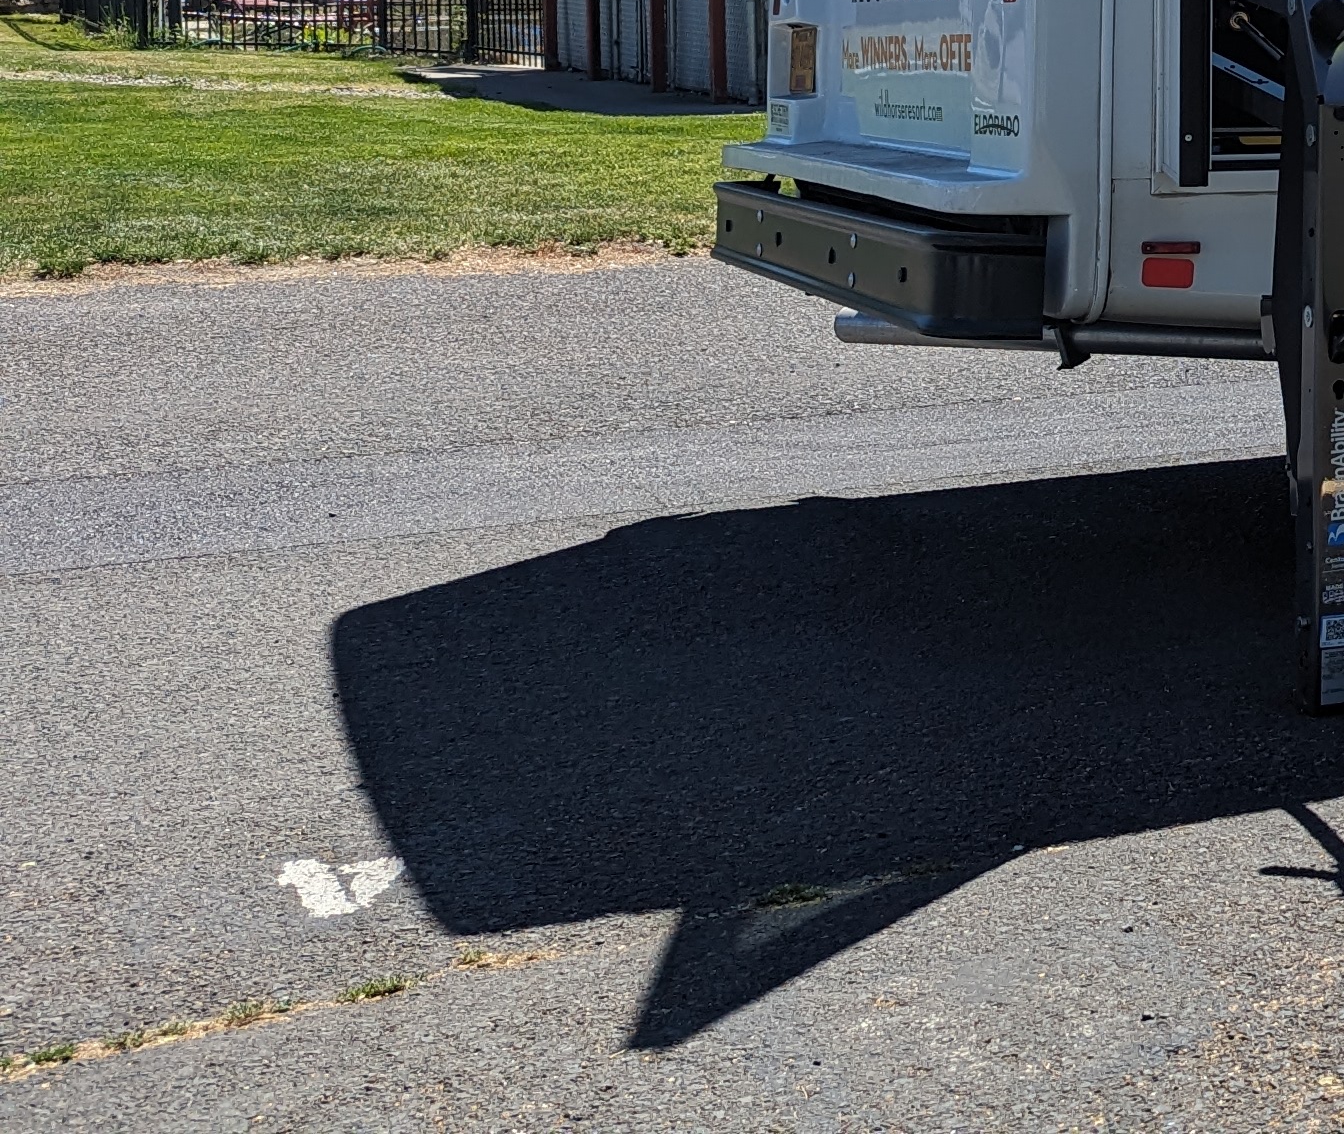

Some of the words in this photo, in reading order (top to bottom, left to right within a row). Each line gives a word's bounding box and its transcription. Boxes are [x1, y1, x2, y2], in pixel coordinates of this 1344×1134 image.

[914, 35, 938, 71] More
[874, 88, 943, 122] wildhorseresort.com
[974, 113, 1020, 137] ELDORADO
